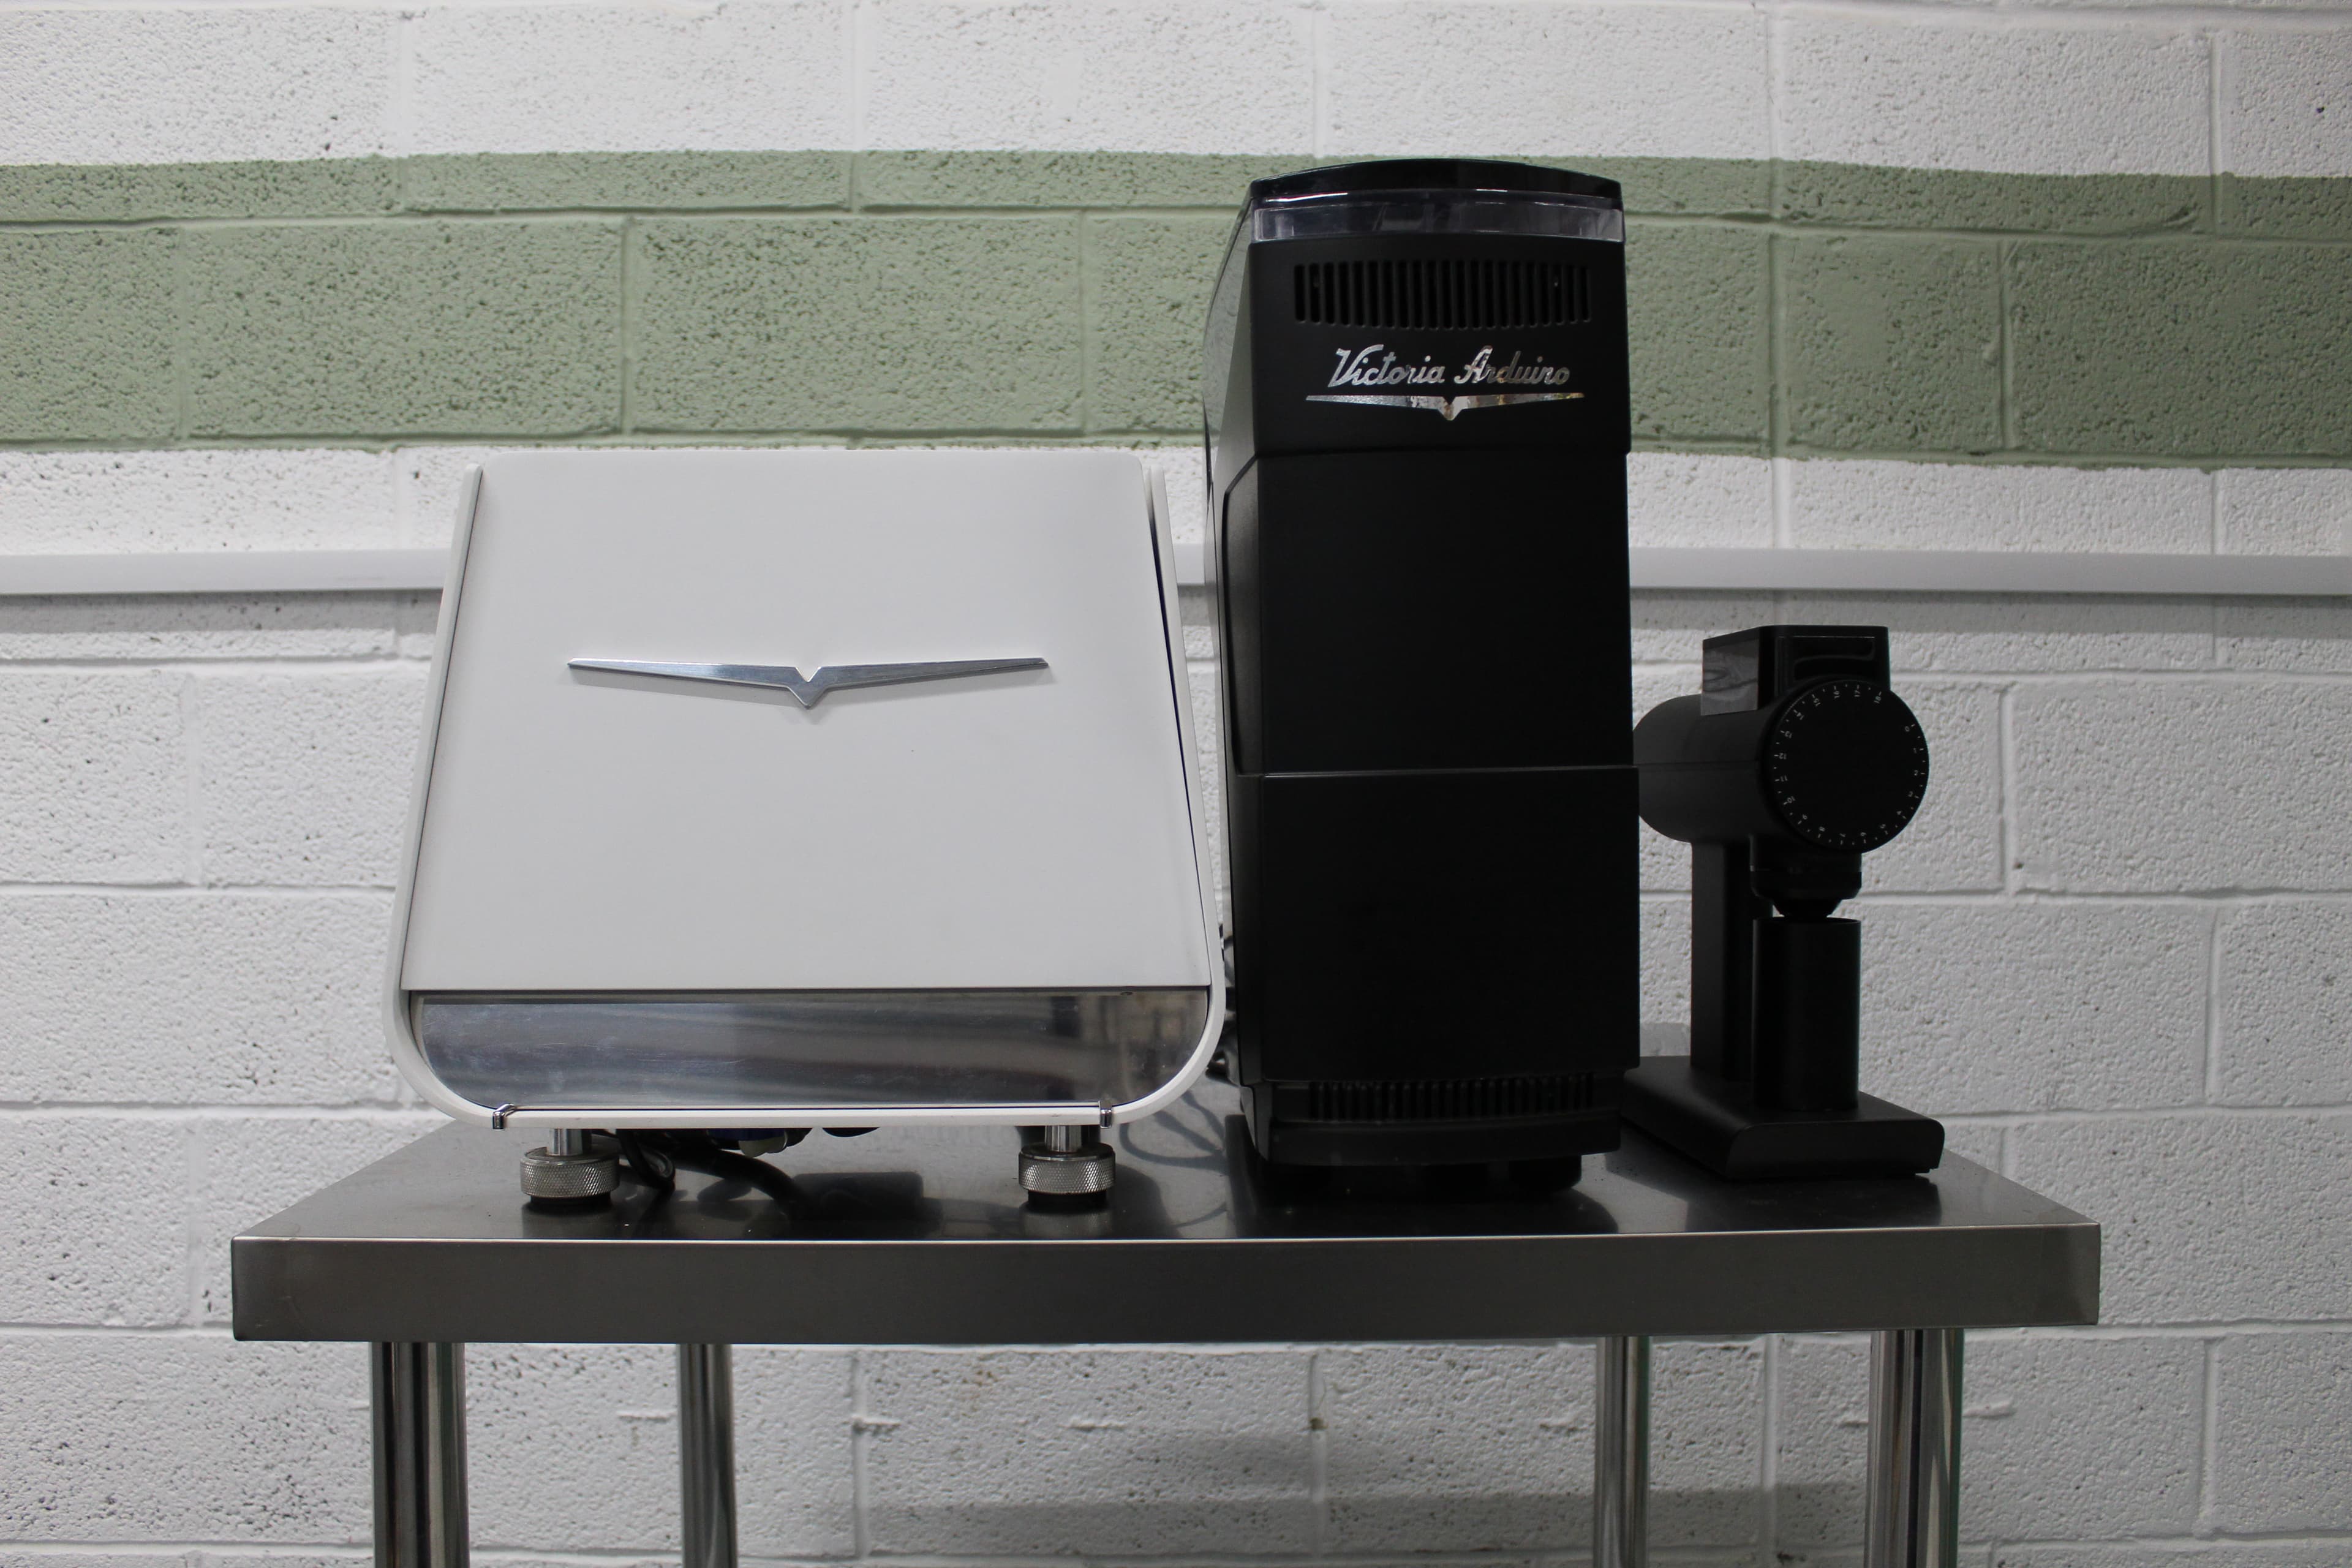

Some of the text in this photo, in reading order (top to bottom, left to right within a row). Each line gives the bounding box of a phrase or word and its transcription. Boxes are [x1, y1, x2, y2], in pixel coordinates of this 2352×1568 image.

[1327, 344, 1570, 387] Victoria Arduino
[1834, 690, 1840, 699] 16
[1813, 698, 1821, 707] 15
